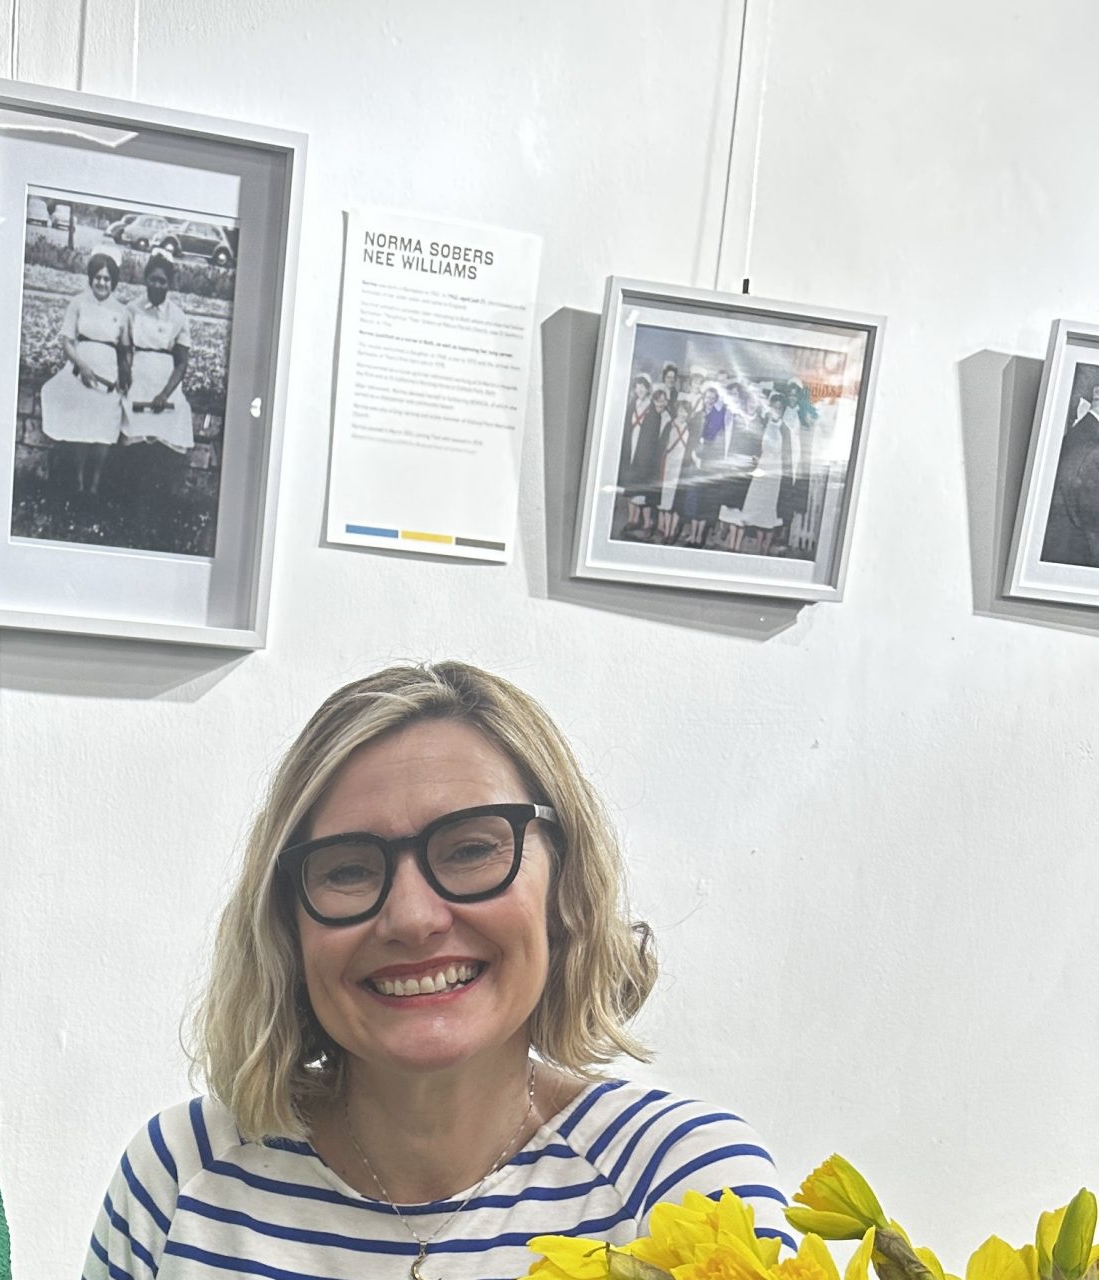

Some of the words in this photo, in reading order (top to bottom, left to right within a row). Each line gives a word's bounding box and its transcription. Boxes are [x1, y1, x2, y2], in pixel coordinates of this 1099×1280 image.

[363, 249, 395, 267] NEE
[402, 254, 477, 280] WILLIAMS
[365, 231, 422, 254] NORMA
[430, 242, 494, 266] SOBERS
